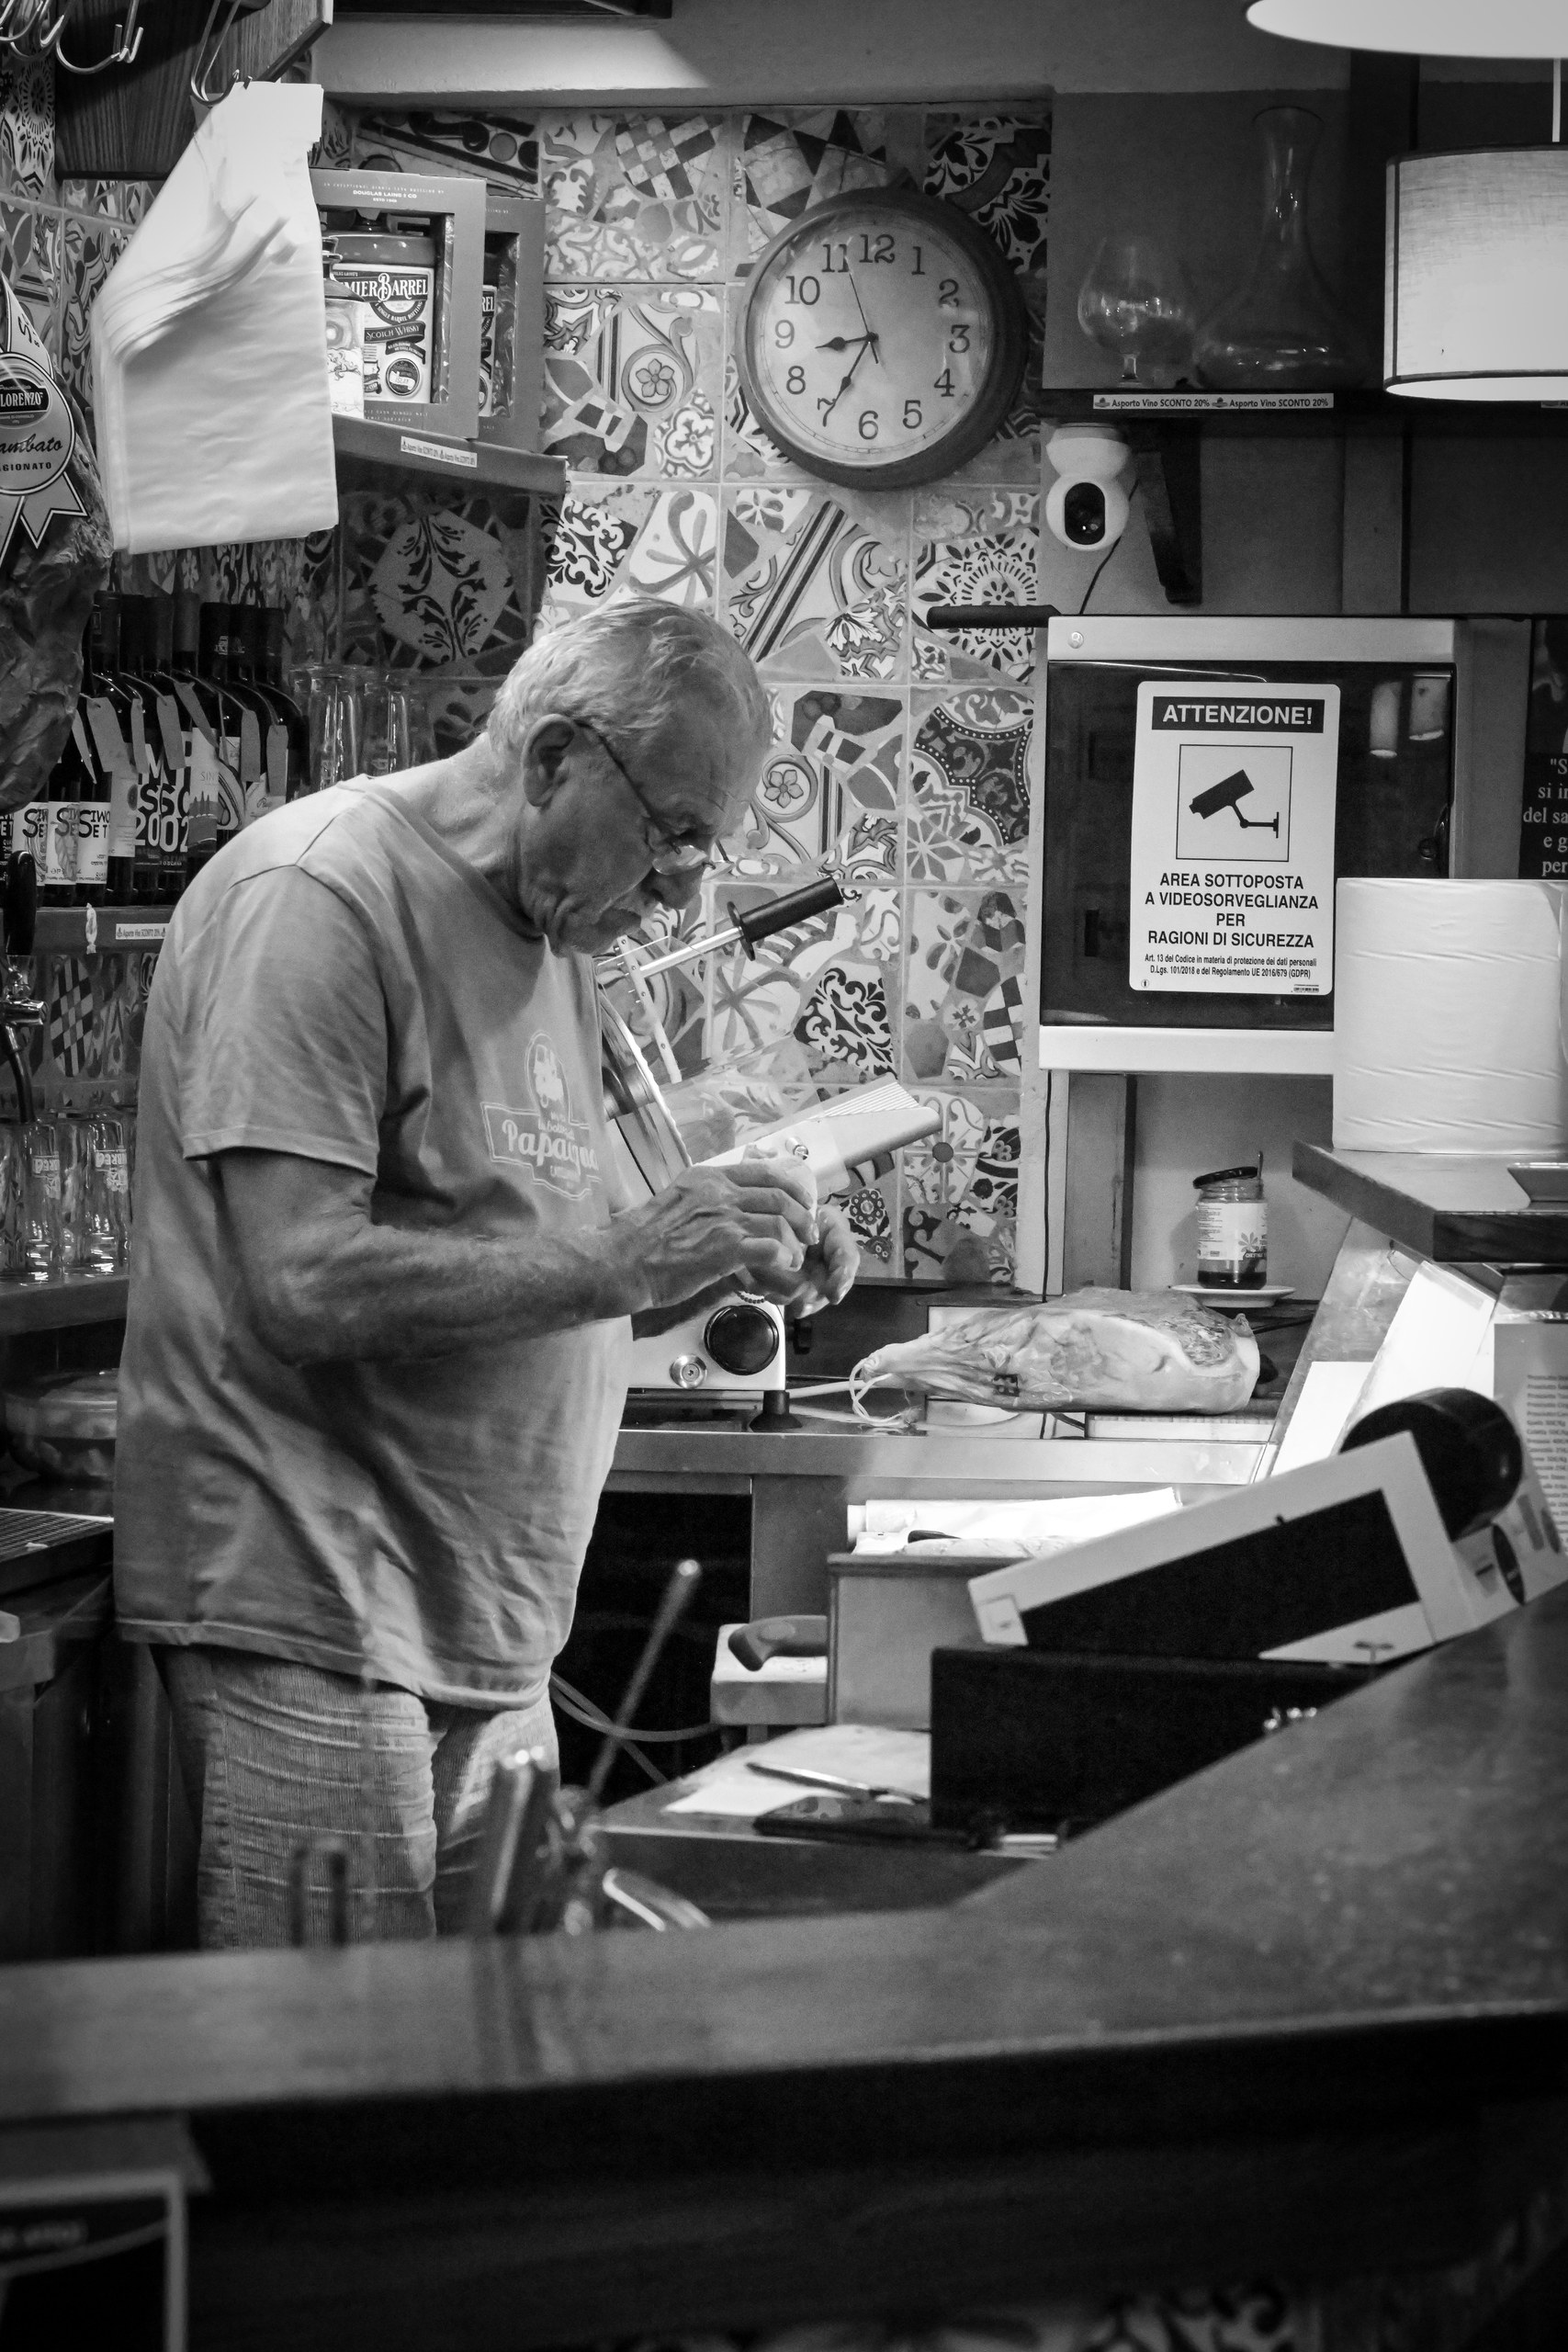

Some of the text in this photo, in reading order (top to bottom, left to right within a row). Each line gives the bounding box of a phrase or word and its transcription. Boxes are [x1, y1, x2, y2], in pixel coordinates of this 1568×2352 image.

[822, 243, 851, 273] 11
[859, 233, 896, 264] 12
[911, 246, 926, 276] 1
[378, 273, 428, 301] BARREL
[784, 276, 821, 305] 10
[939, 278, 960, 308] 2
[366, 325, 420, 340] SCOTCH WHISKY
[774, 319, 795, 348] 9
[949, 324, 971, 354] 3
[785, 365, 807, 395] 8
[933, 368, 955, 397] 4
[817, 397, 837, 428] 7
[902, 400, 923, 429] 5
[1111, 398, 1329, 409] Asporto Vino SCONTO 20% Asporto Vino SCONTO 20%
[858, 410, 879, 440] 6
[0, 462, 51, 471] GIONATO
[1162, 704, 1313, 725] ATTENZIONE!
[1538, 783, 1551, 798] si
[1523, 807, 1547, 823] del
[1543, 836, 1552, 848] e
[1159, 873, 1304, 889] AREA SOTTOPOSTA
[1145, 892, 1319, 910] A VIDEOSORVEGLIANZA
[1216, 912, 1246, 927] PER
[1148, 930, 1314, 948] RAGIONI DI SICUREZZA
[1145, 954, 1317, 968] Art. 13 del Codice in materia di protezione dei dati personali
[1150, 966, 1168, 976] D.Lgs.
[1170, 966, 1195, 975] 101/2018
[1201, 967, 1211, 975] del
[1212, 967, 1250, 978] Regolamento
[1251, 968, 1260, 977] UE
[1261, 968, 1287, 978] 2016/679
[1288, 968, 1311, 979] (GDPR)
